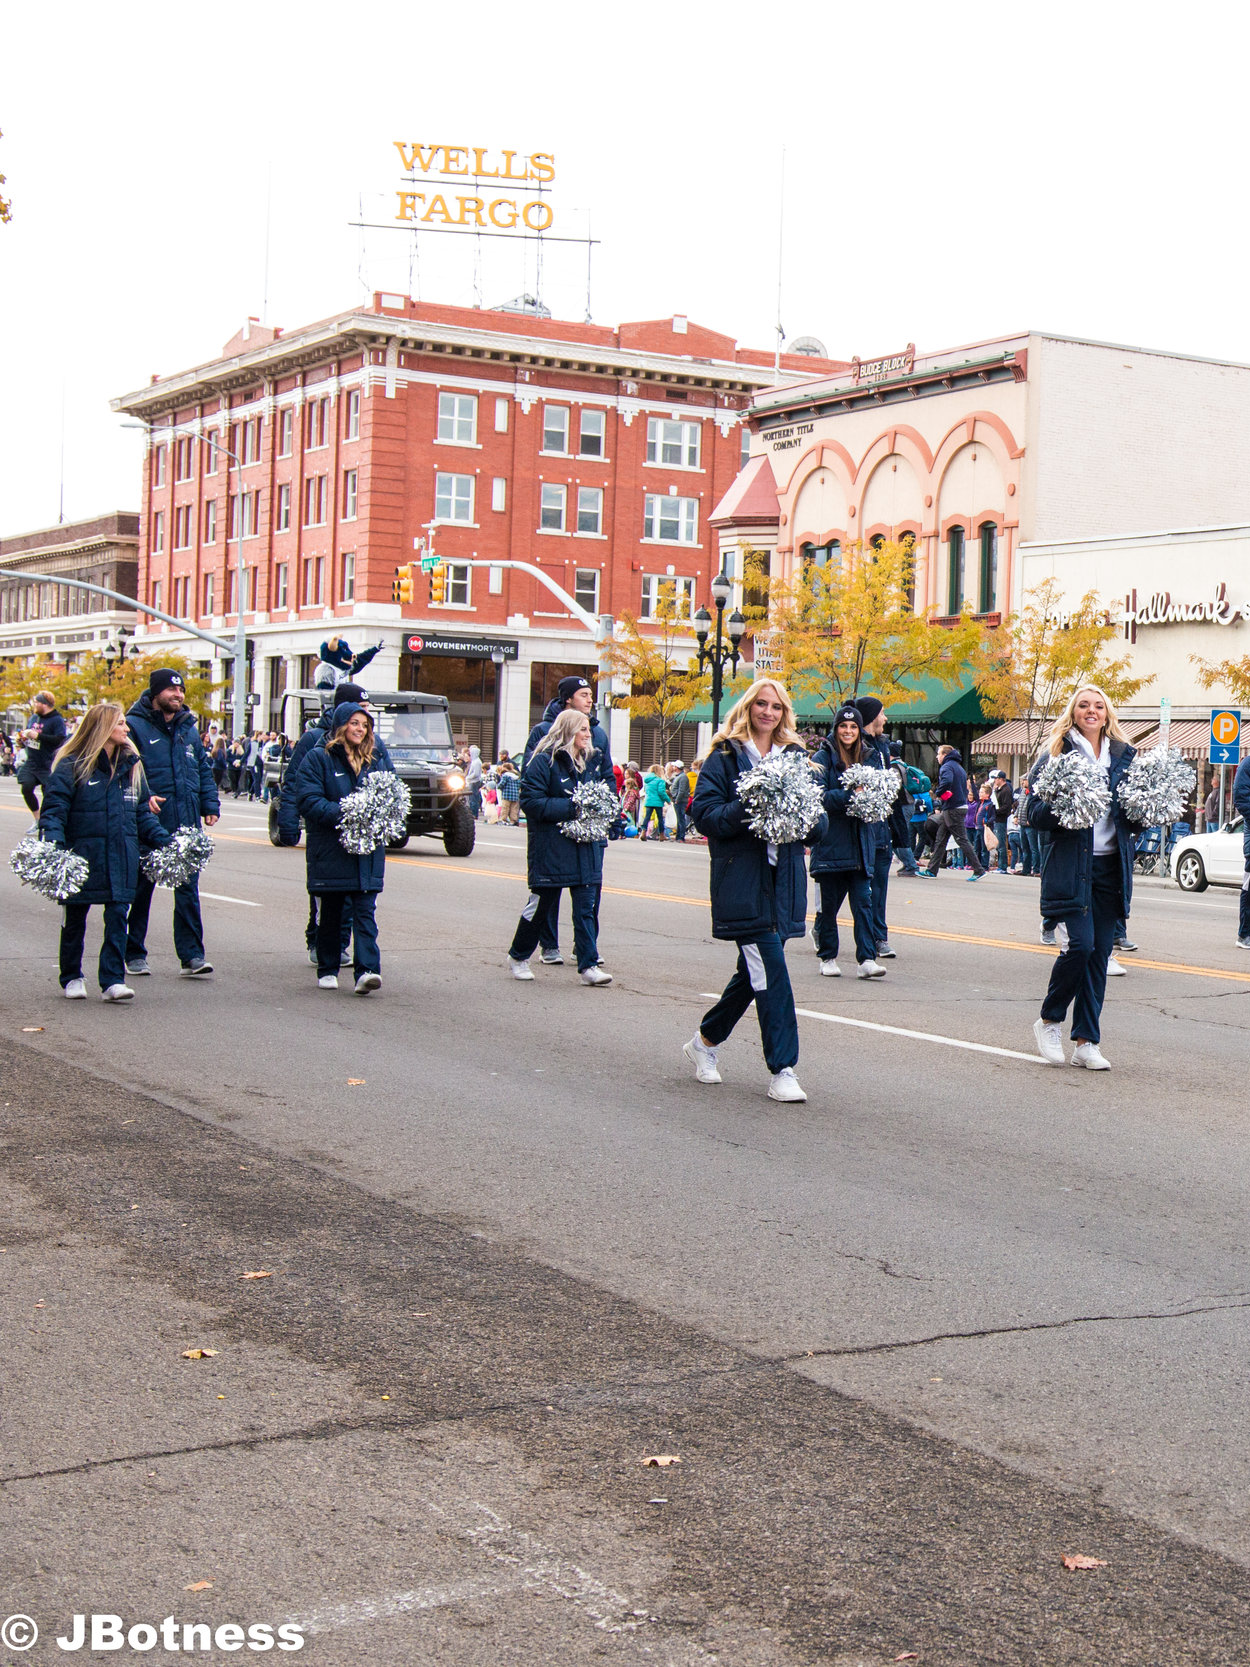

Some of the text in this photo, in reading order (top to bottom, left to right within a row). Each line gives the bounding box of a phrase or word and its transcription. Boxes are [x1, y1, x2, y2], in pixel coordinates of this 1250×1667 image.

[393, 141, 556, 182] WELLS
[395, 191, 554, 231] FARGO
[860, 361, 883, 378] BUDGE
[883, 356, 906, 372] BLOCK
[762, 423, 814, 442] NORTHERN TITLE
[773, 437, 802, 451] COMPANY
[1118, 582, 1241, 644] Hallmark
[1219, 718, 1234, 740] P
